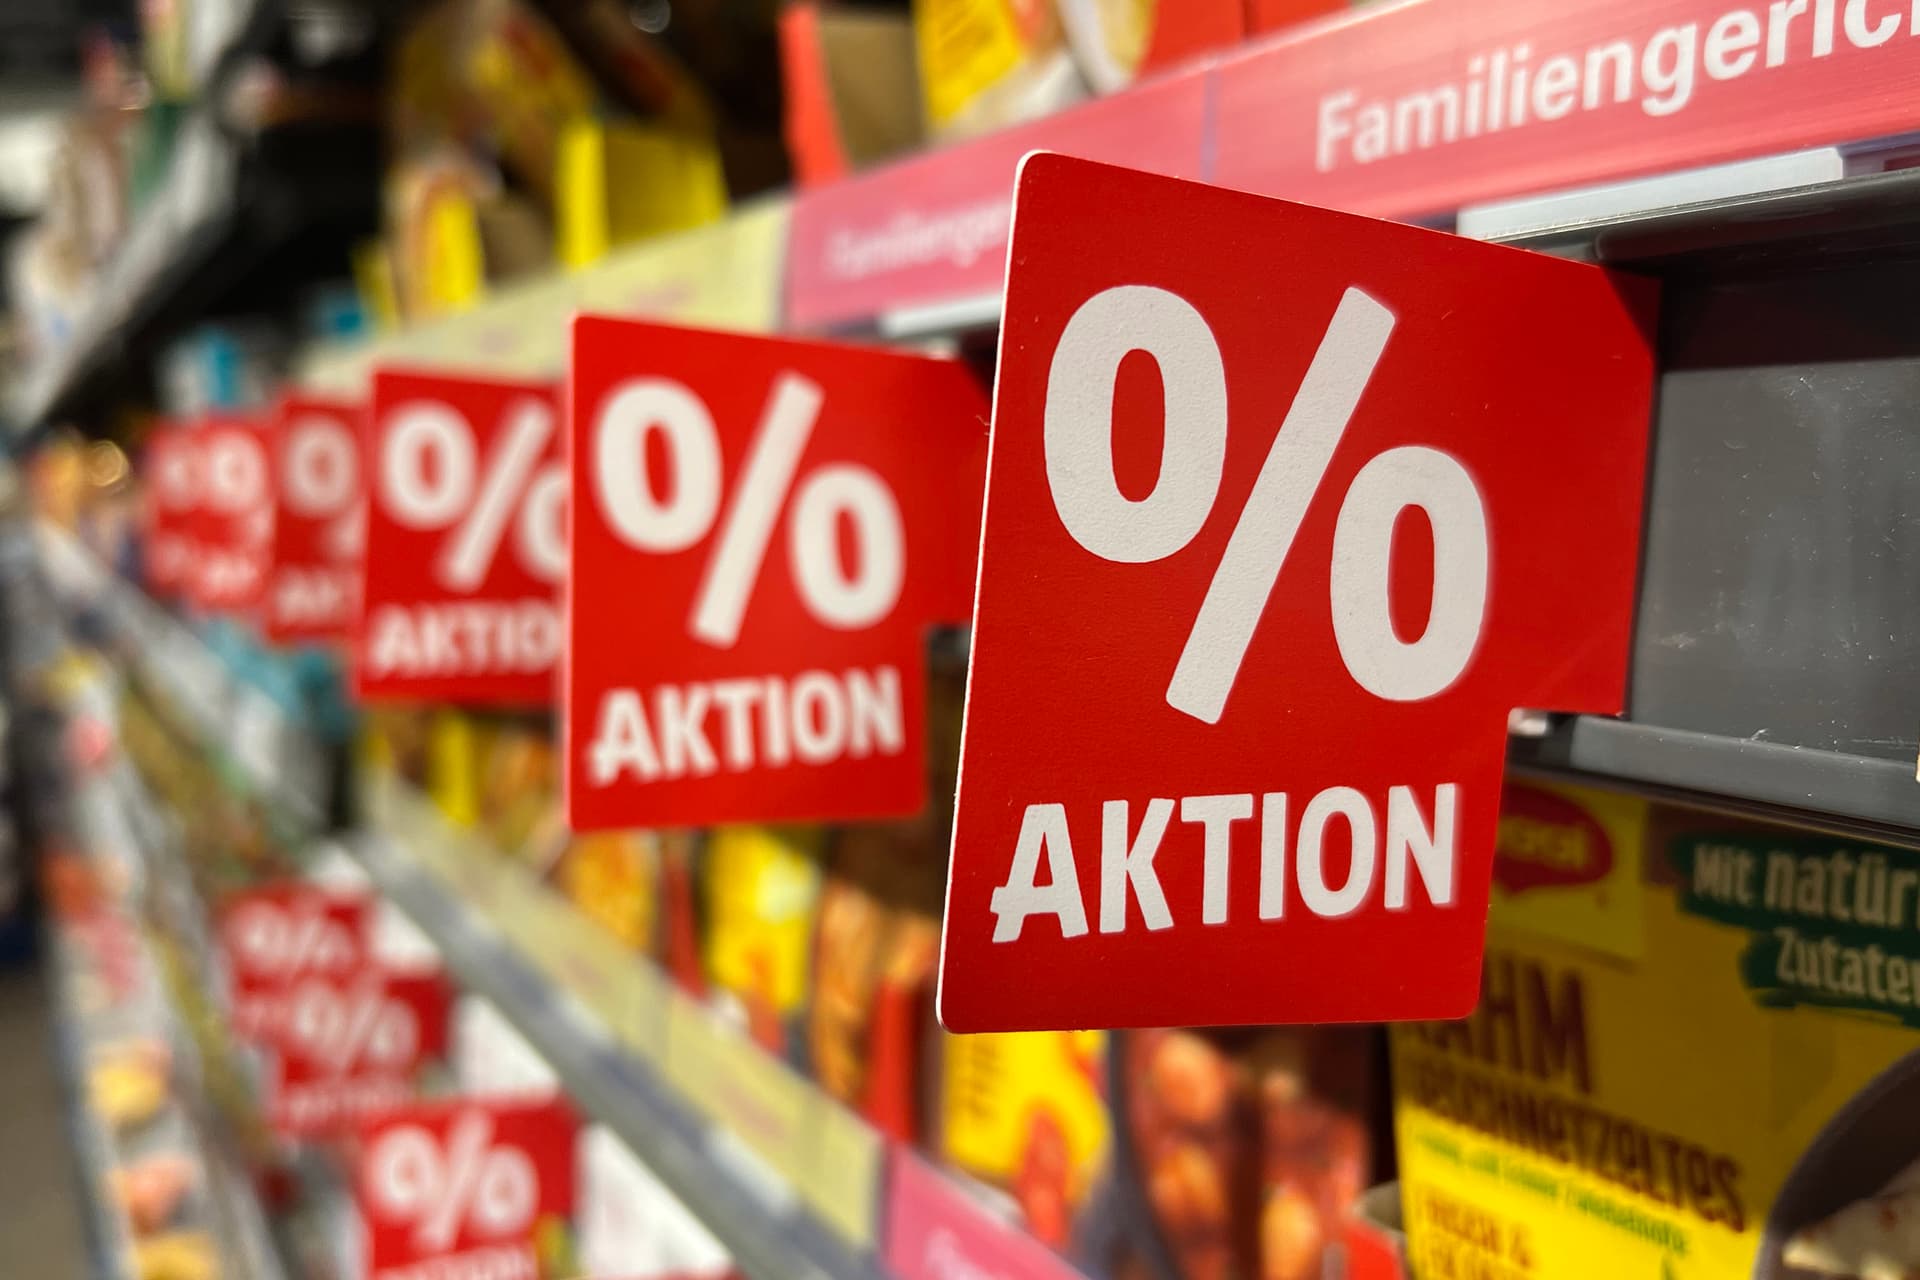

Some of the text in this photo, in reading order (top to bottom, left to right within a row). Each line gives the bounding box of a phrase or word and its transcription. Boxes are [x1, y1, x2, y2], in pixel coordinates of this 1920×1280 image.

[1317, 0, 1920, 171] Familiengeric
[591, 371, 905, 646] %
[1044, 284, 1488, 724] %
[368, 604, 563, 678] AKTIO
[587, 667, 904, 785] AKTION
[990, 783, 1457, 943] AKTION
[1694, 844, 1920, 928] Mit natür
[368, 1108, 541, 1248] %
